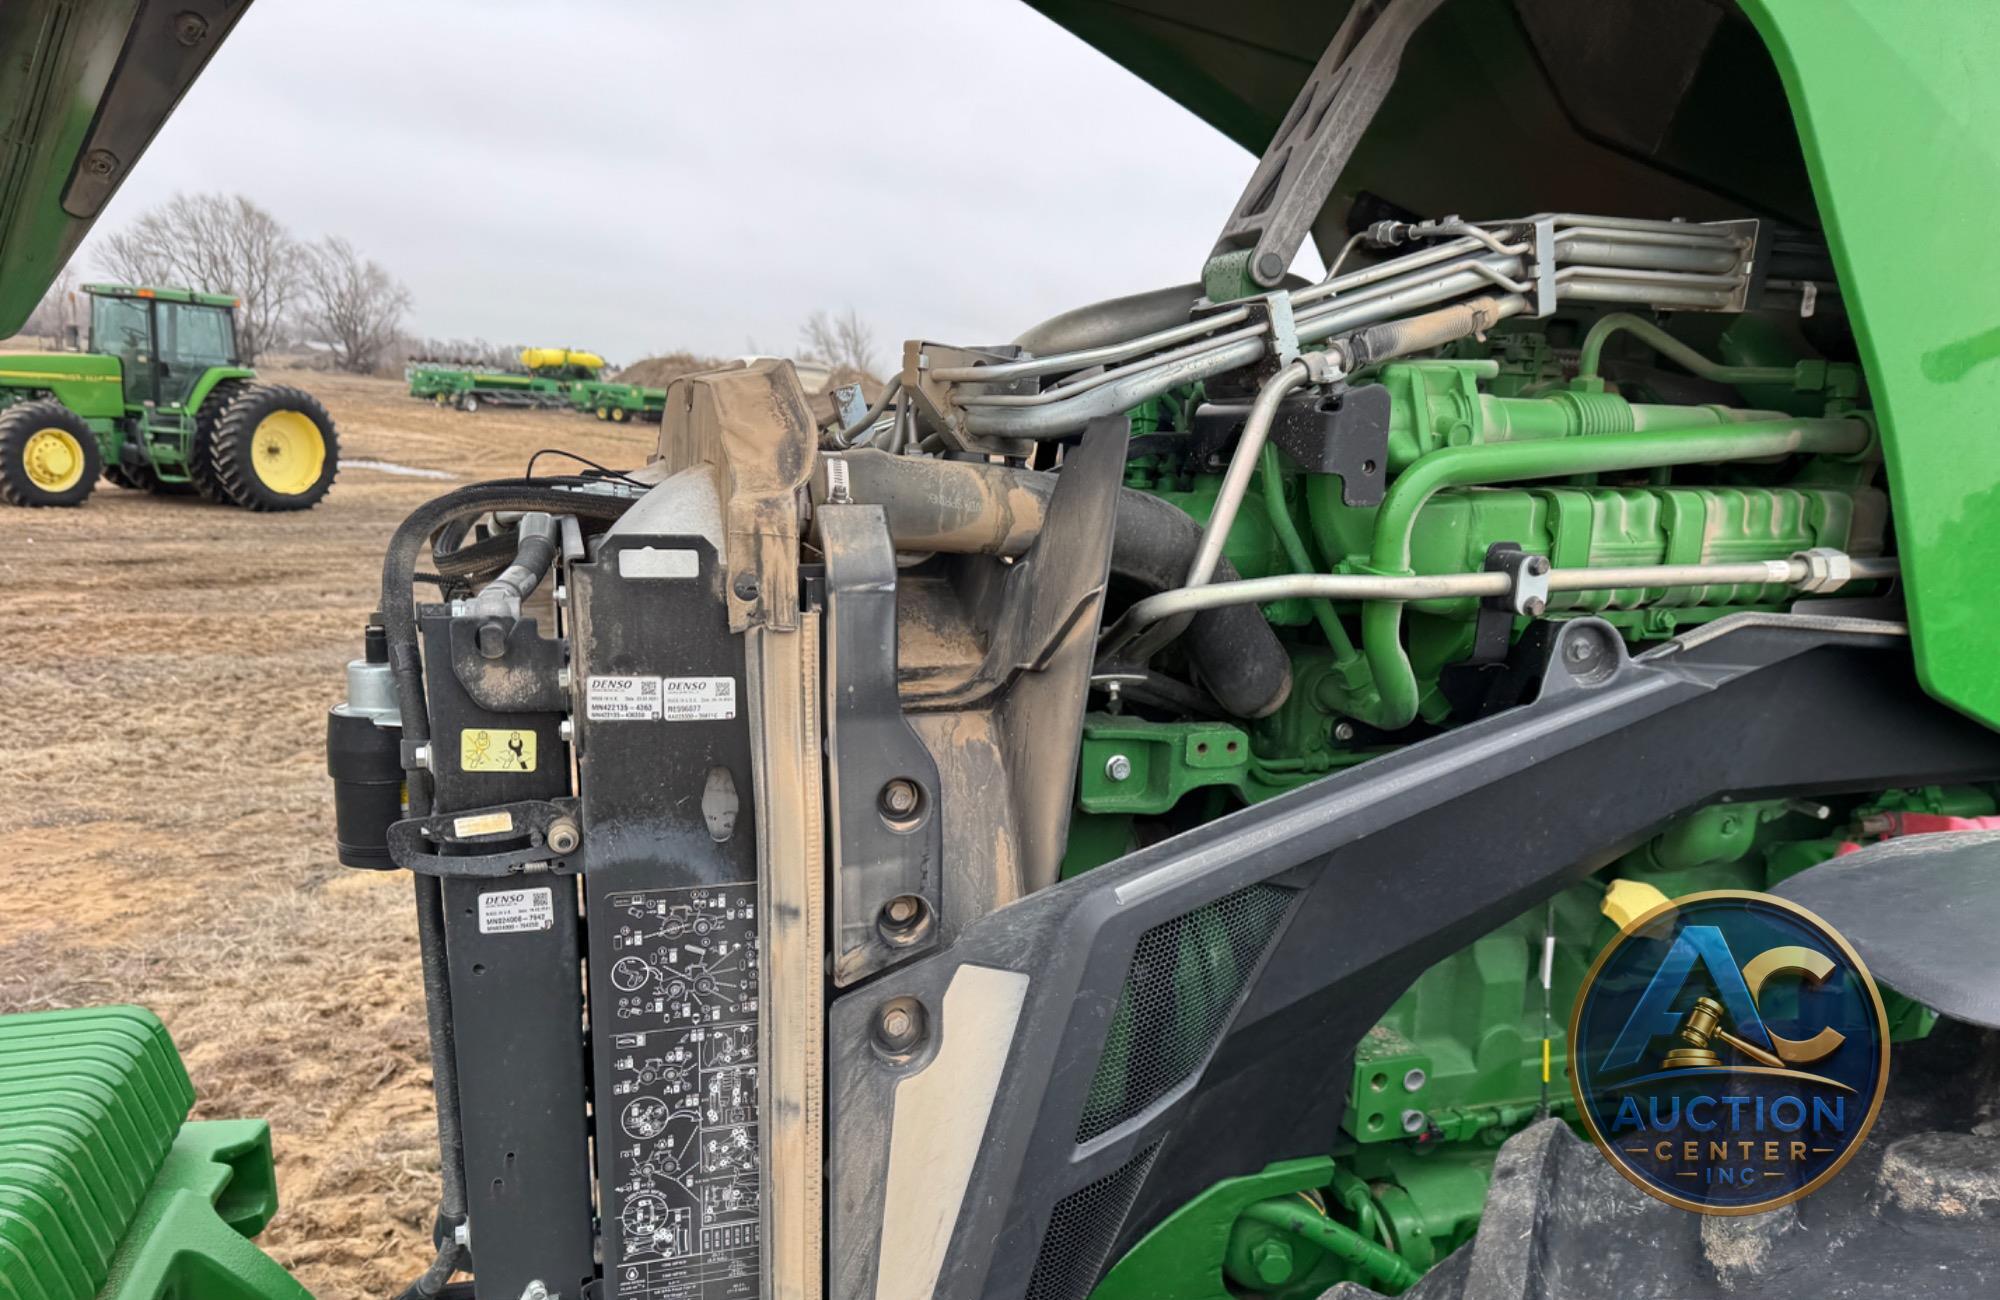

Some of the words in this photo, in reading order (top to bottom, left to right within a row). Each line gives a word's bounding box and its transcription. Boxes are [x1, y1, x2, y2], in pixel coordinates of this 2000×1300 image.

[591, 679, 633, 689] DENSO
[667, 681, 707, 691] DENSO
[485, 894, 525, 905] DENSO
